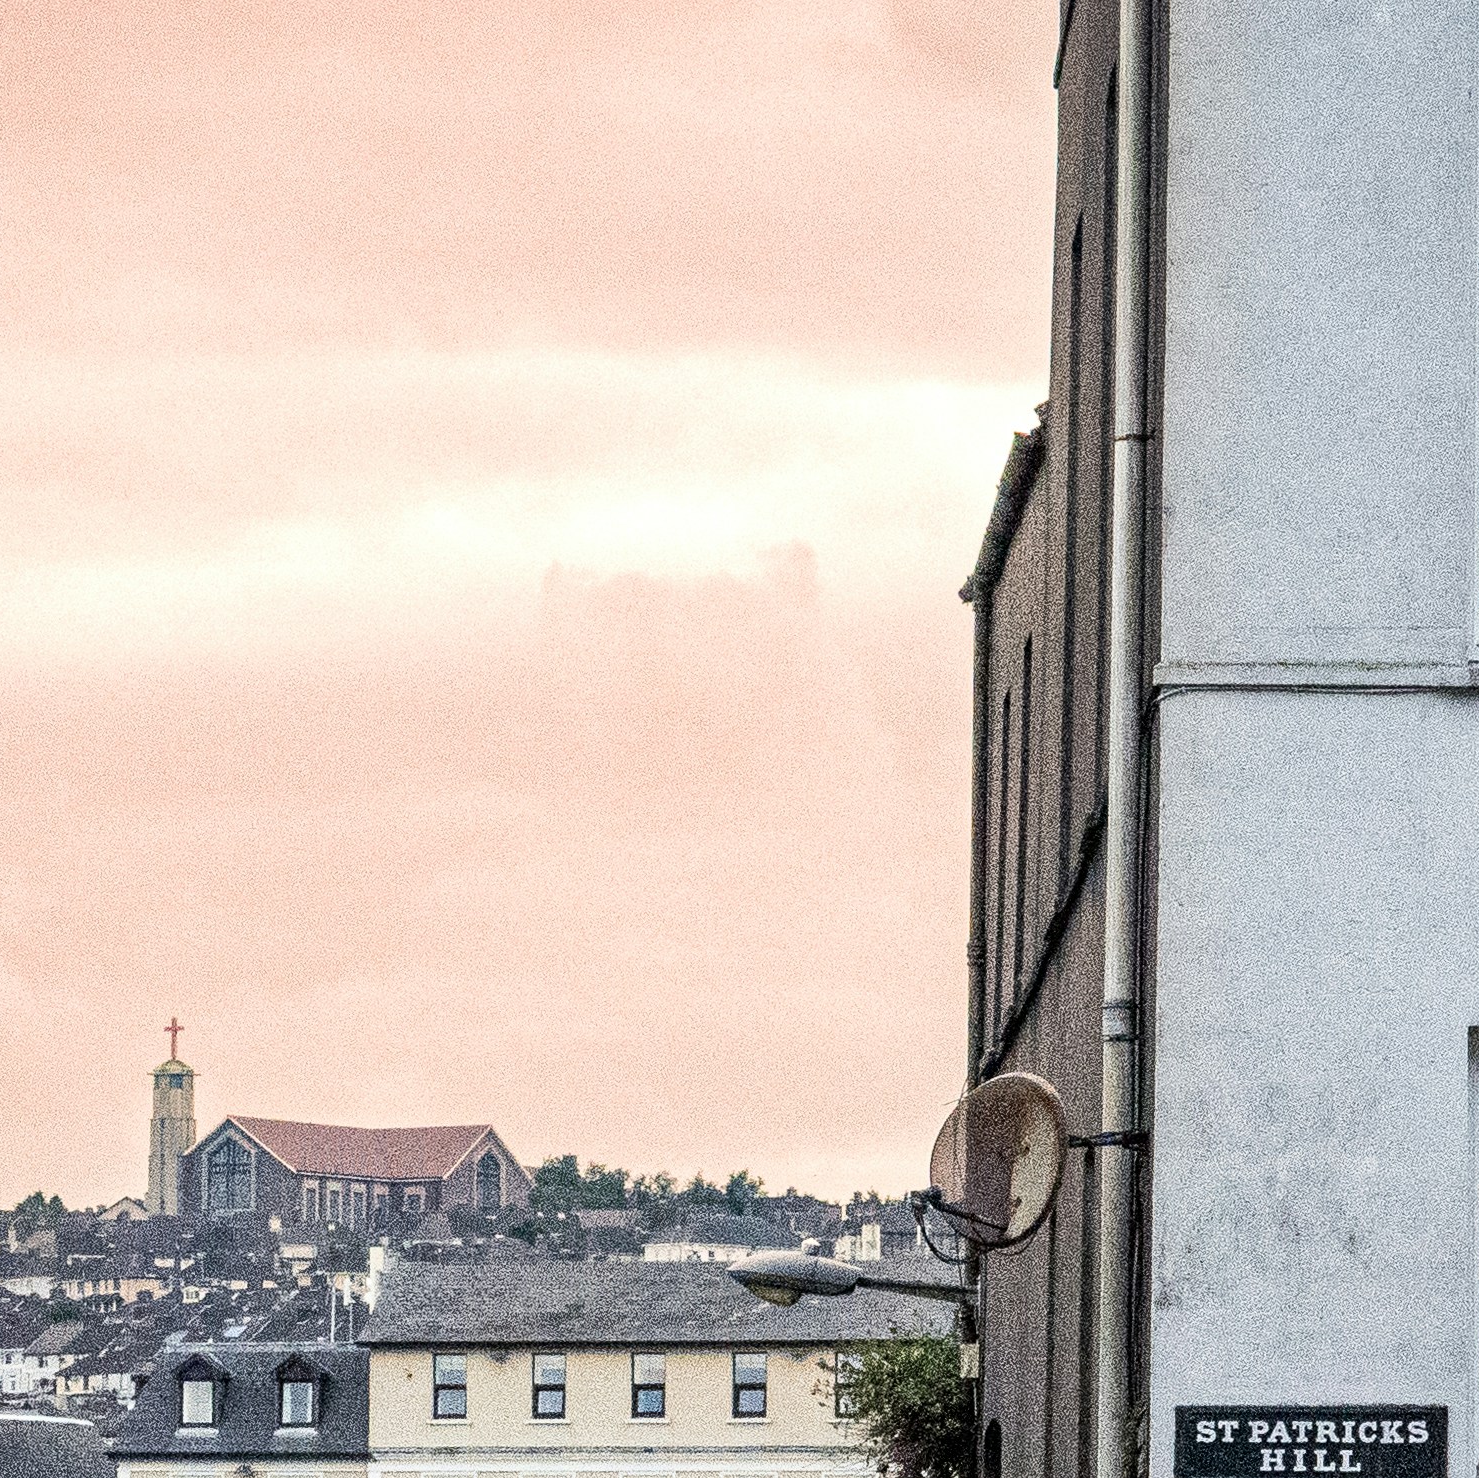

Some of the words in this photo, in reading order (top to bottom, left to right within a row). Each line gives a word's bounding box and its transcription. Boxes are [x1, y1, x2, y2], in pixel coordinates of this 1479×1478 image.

[1195, 1420, 1238, 1443] ST
[1247, 1420, 1430, 1443] PATRICKS
[1259, 1449, 1362, 1472] HILL
